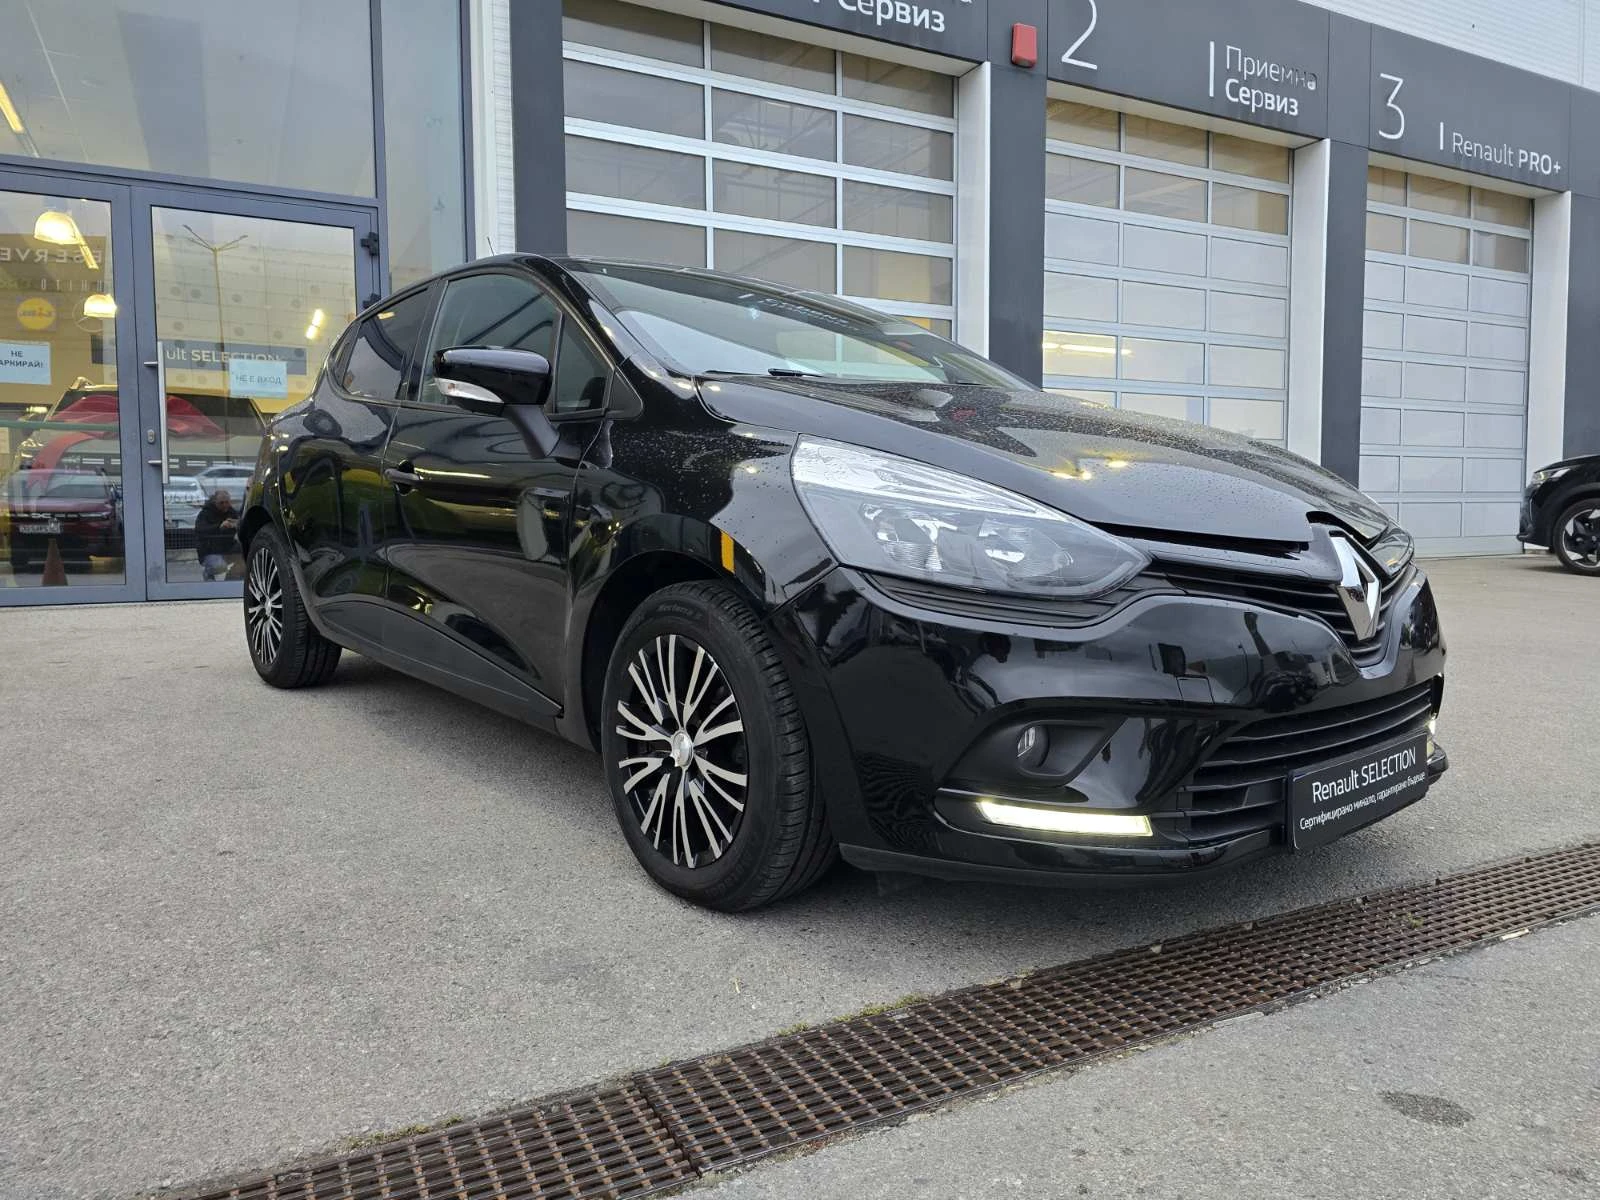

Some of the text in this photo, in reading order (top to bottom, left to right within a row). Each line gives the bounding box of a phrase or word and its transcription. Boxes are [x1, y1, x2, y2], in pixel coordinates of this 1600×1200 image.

[1061, 0, 1098, 70] 2
[1226, 45, 1318, 91] Приемна
[1225, 78, 1299, 116] Сервиз
[1378, 72, 1406, 140] 3
[1452, 131, 1562, 175] Renault PRO+
[10, 350, 24, 358] НЕ
[1312, 747, 1416, 804] Renault SELECTION
[1300, 803, 1353, 831] Сертифицирано
